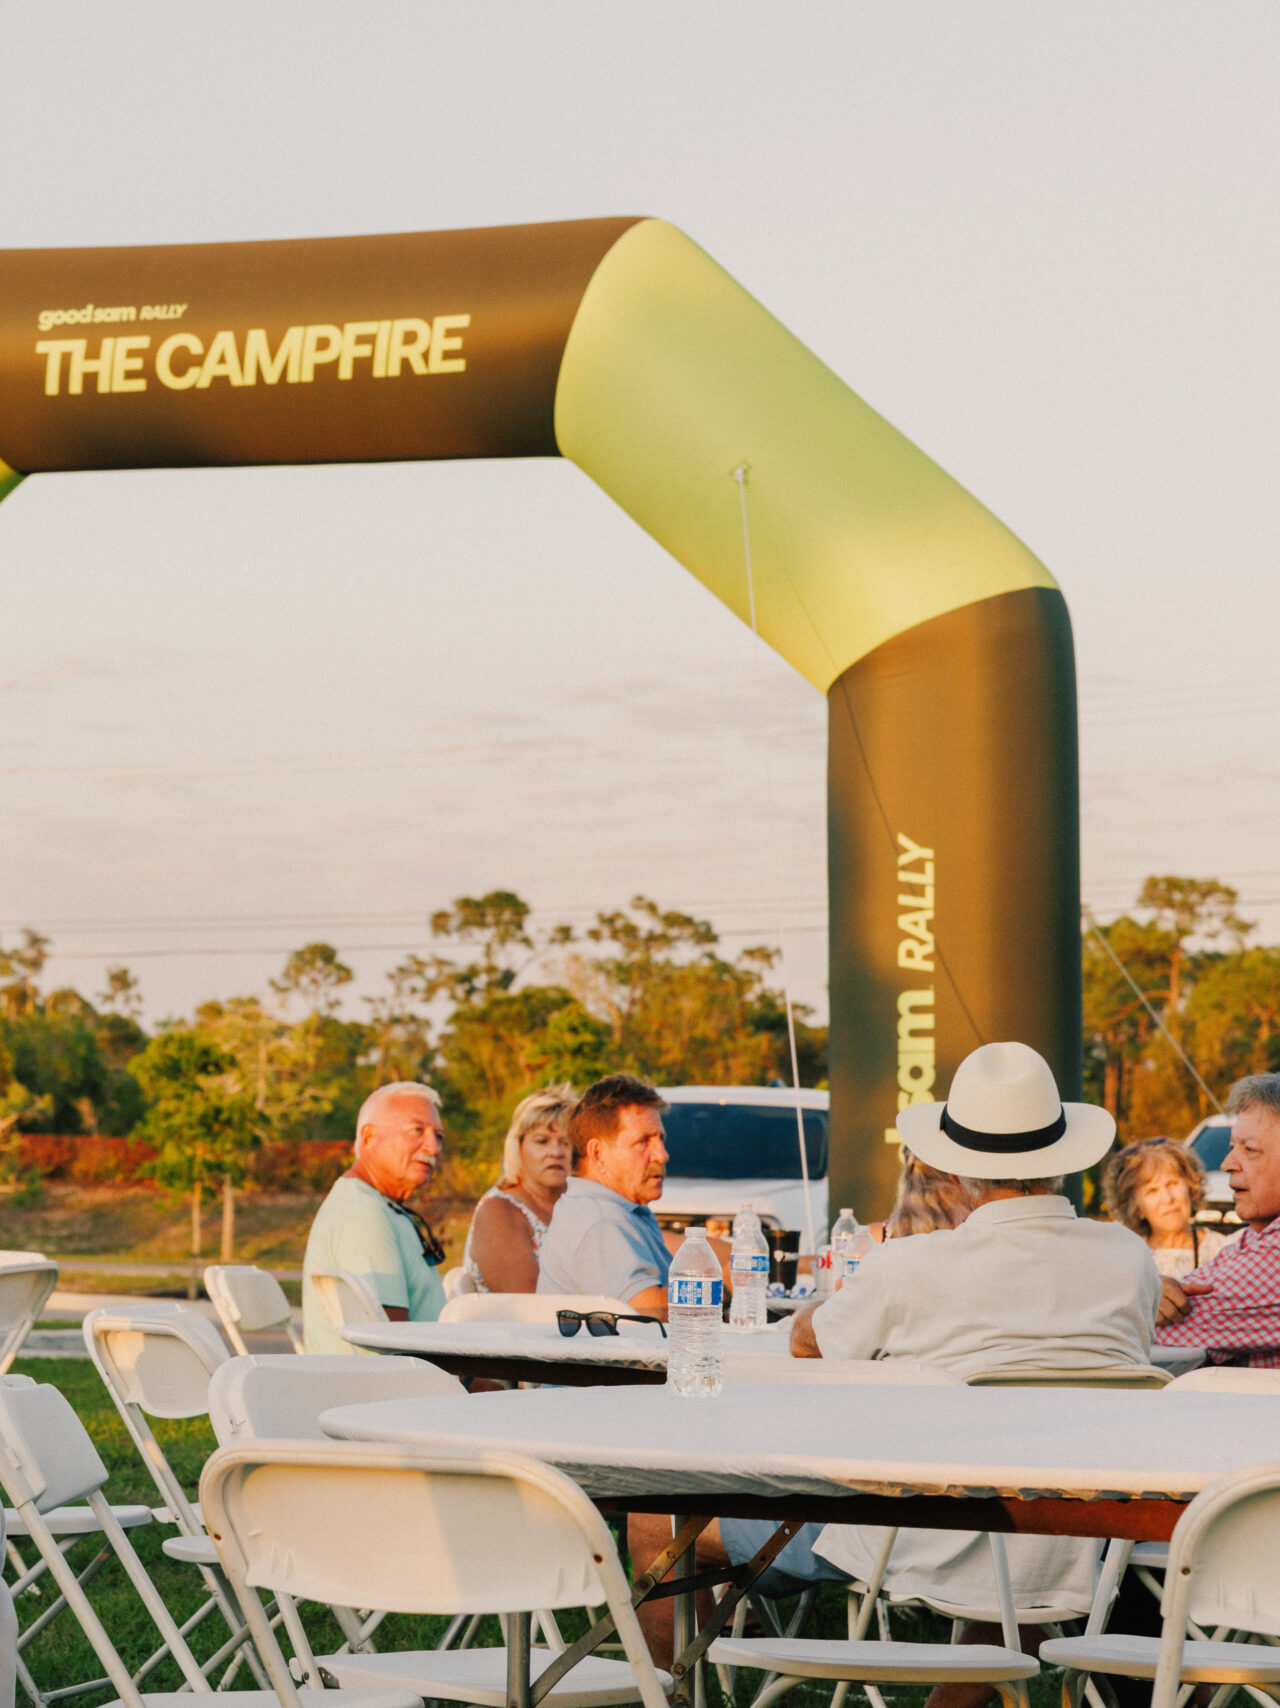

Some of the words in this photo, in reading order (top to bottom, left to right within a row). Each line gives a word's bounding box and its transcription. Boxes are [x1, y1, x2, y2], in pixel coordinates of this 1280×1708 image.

[139, 304, 188, 320] RALLY
[35, 335, 151, 396] THE
[155, 314, 471, 391] CAMPFIRE
[897, 832, 935, 972] RALLY
